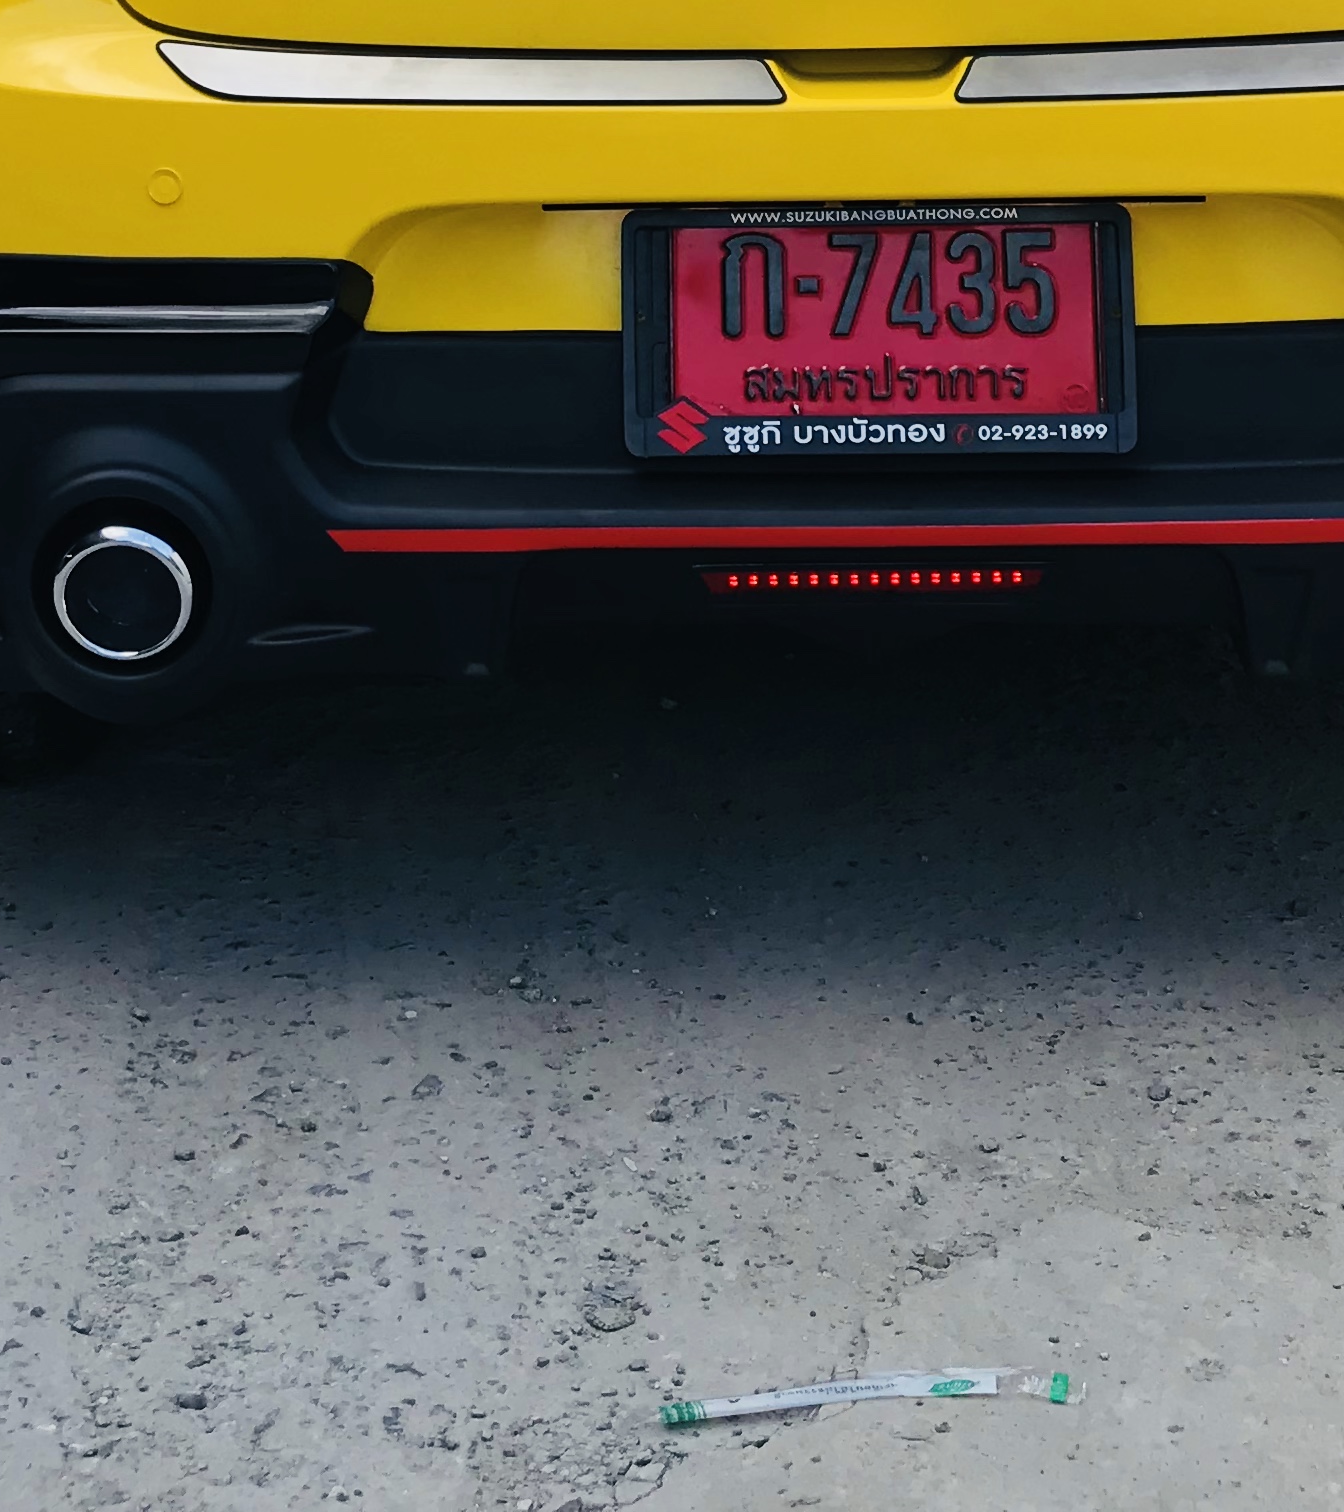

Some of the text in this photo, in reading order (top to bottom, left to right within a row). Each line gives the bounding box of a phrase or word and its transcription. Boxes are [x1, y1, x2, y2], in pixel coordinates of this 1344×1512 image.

[731, 207, 1018, 224] WWW.SUZUKIBANGBUATHONG.COM
[720, 231, 1057, 338] ก-7435
[744, 353, 1026, 414] สมุทรปราการ
[722, 418, 1108, 453] ซูซูกิ บางบัวทอง 02-923-1899
